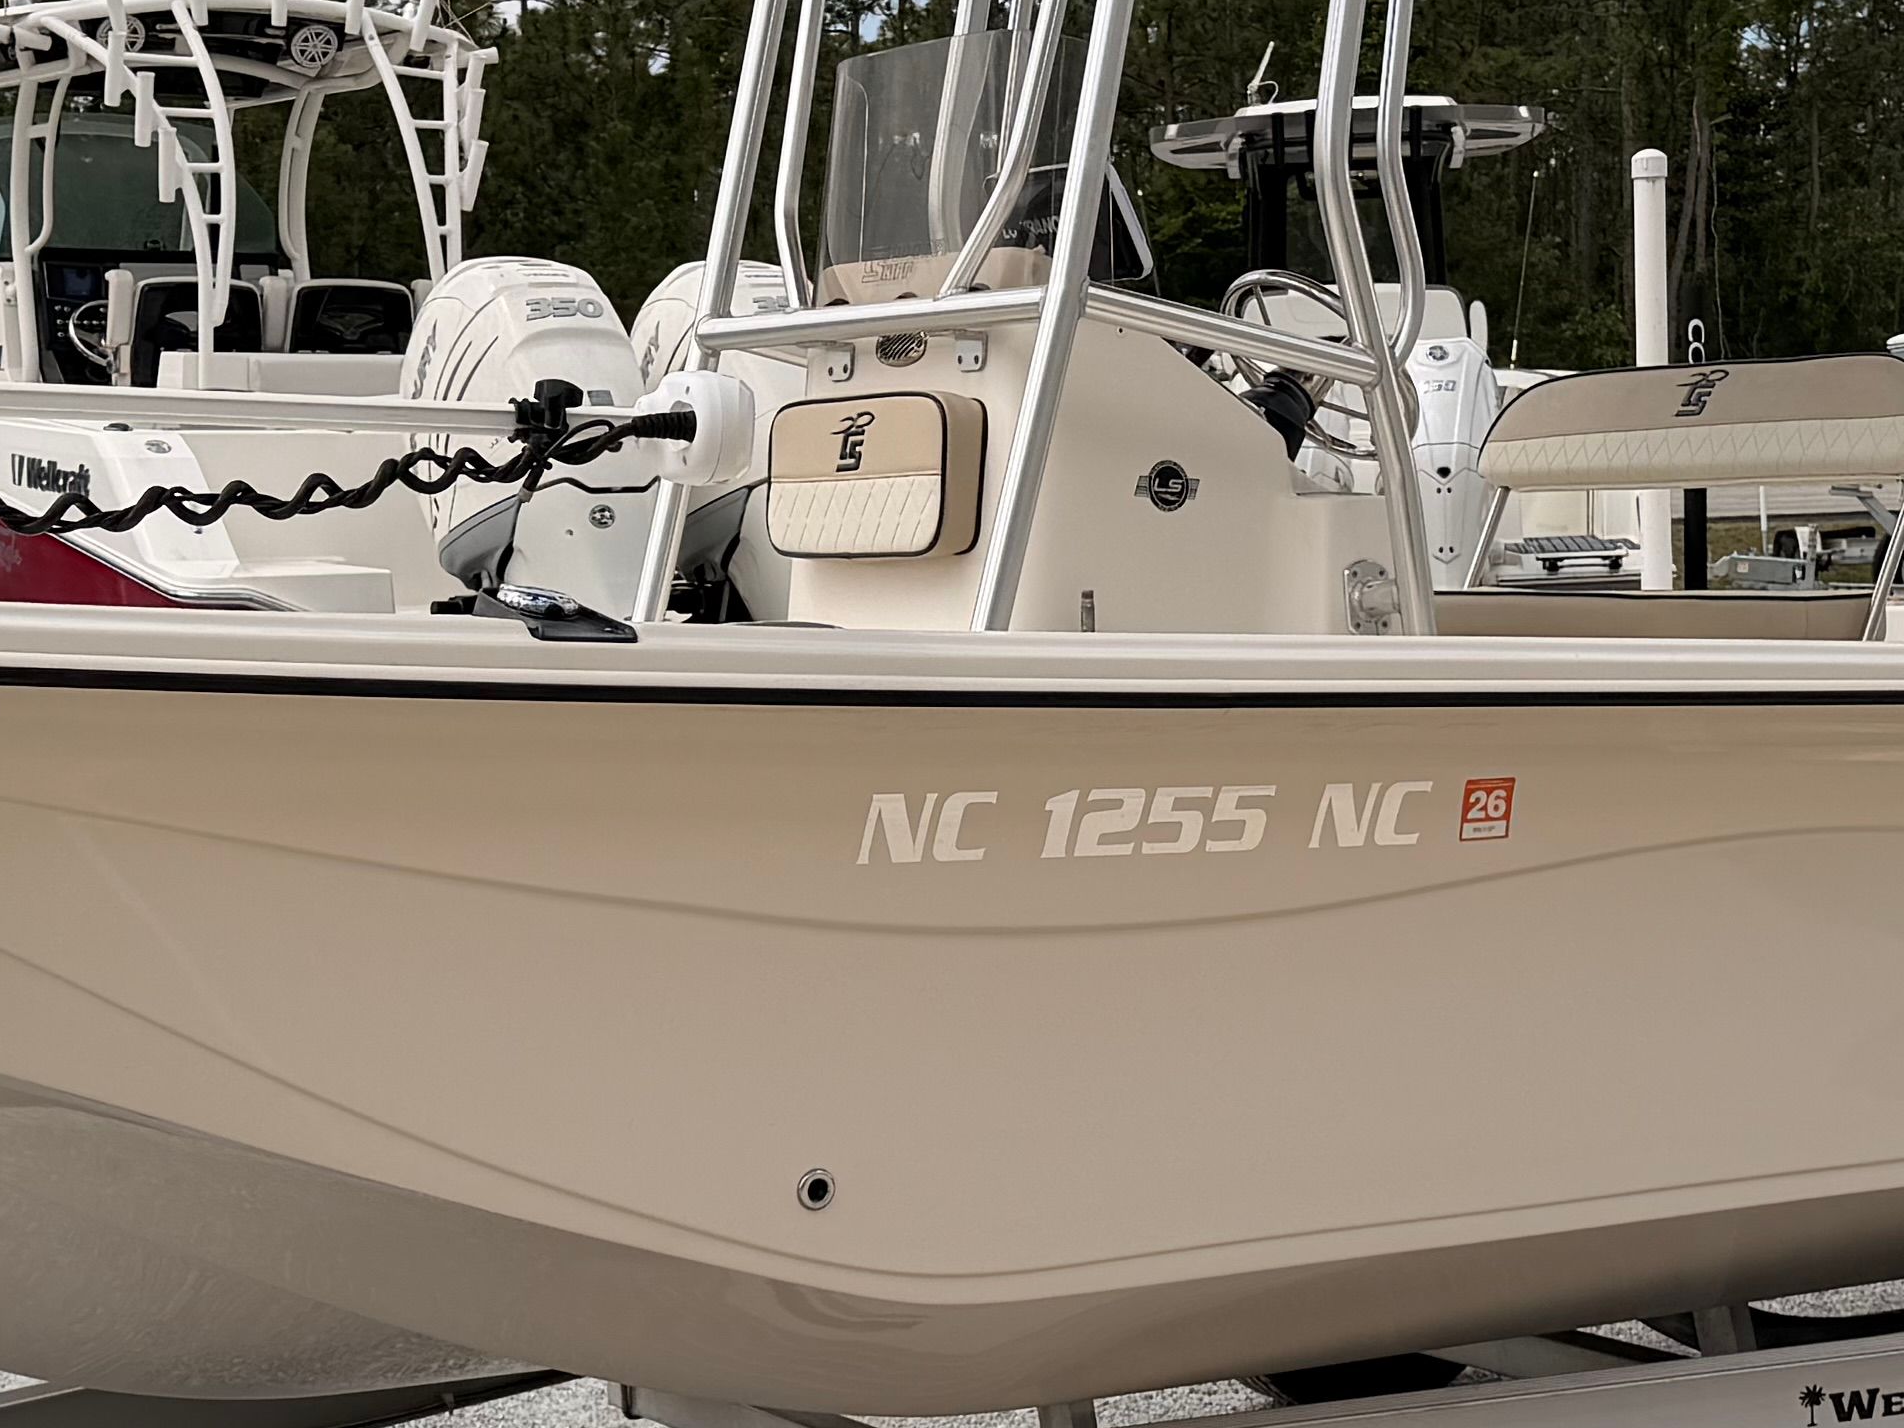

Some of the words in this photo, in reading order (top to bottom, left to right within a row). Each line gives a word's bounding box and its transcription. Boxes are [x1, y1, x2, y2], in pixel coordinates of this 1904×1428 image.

[525, 296, 605, 322] 350
[1153, 477, 1184, 493] LS
[1466, 789, 1508, 820] 26
[856, 791, 998, 865] NC
[1040, 784, 1277, 858] 1255
[1308, 780, 1433, 849] NC
